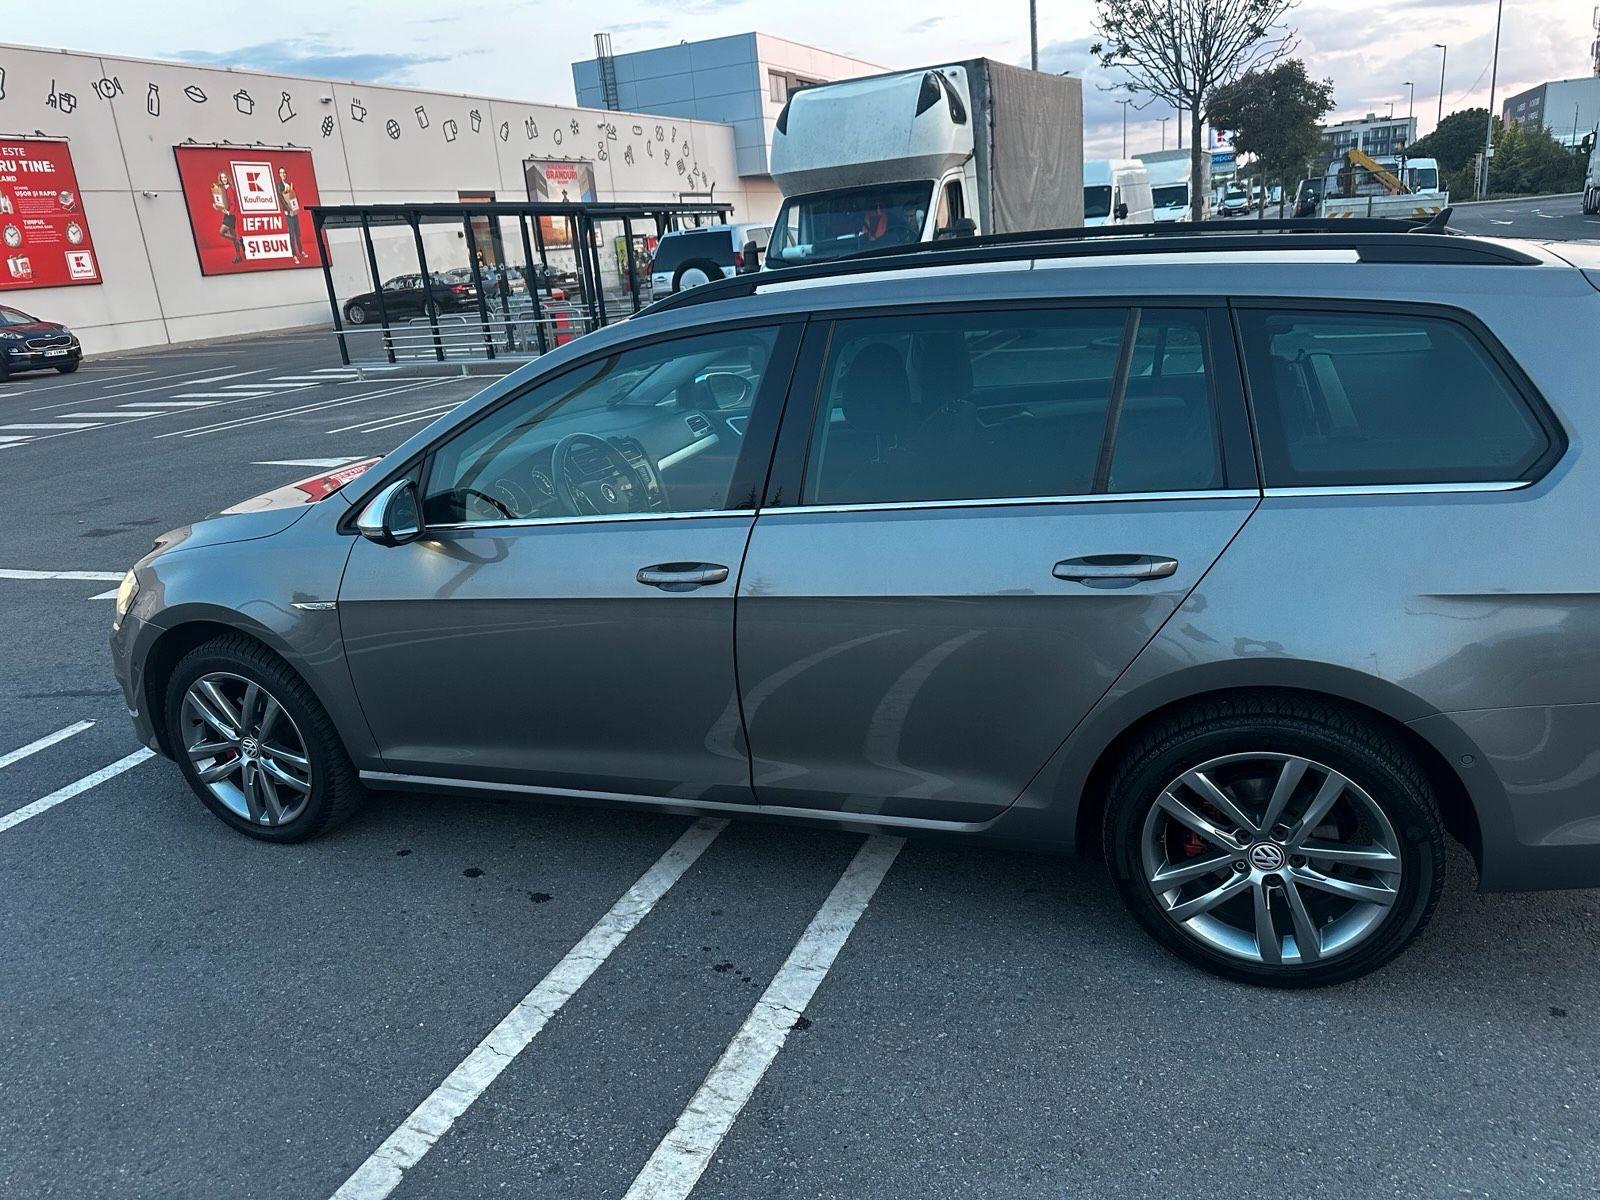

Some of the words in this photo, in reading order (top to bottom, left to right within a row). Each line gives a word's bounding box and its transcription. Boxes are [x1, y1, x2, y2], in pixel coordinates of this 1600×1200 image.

[1, 147, 26, 156] ESTE
[19, 160, 55, 173] TINE:
[244, 195, 273, 204] Kaufland
[242, 216, 283, 231] IEFTIN
[248, 240, 261, 257] ȘI
[262, 239, 290, 253] BUN
